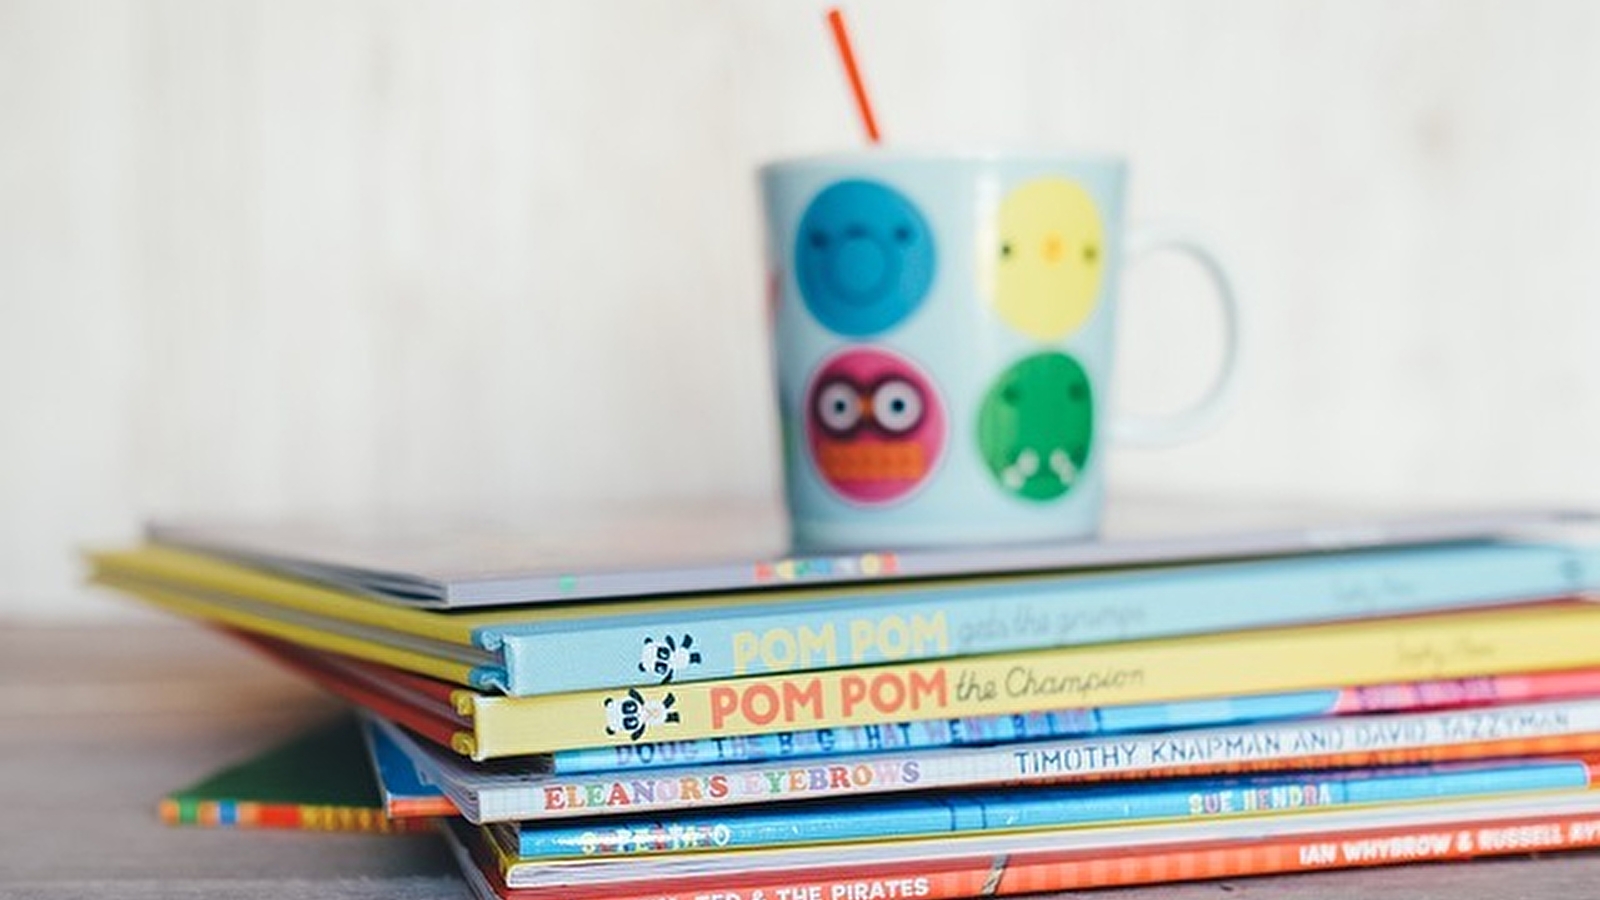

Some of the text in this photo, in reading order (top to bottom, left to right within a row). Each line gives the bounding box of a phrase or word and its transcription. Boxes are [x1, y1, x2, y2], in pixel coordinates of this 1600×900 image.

[732, 626, 836, 675] POM
[850, 611, 949, 662] POM
[709, 665, 1145, 730] POM POM the Champion
[1014, 745, 1137, 775] TIMOTHY
[1150, 733, 1282, 764] KNAPMAN
[1293, 727, 1345, 751] AND
[1354, 718, 1428, 745] DAVID
[544, 761, 920, 810] ELEANOR'S EYEBROWS
[1189, 789, 1234, 815] SUE
[1299, 843, 1337, 866] IAN
[776, 885, 823, 900] THE
[830, 876, 929, 899] PIRATES
